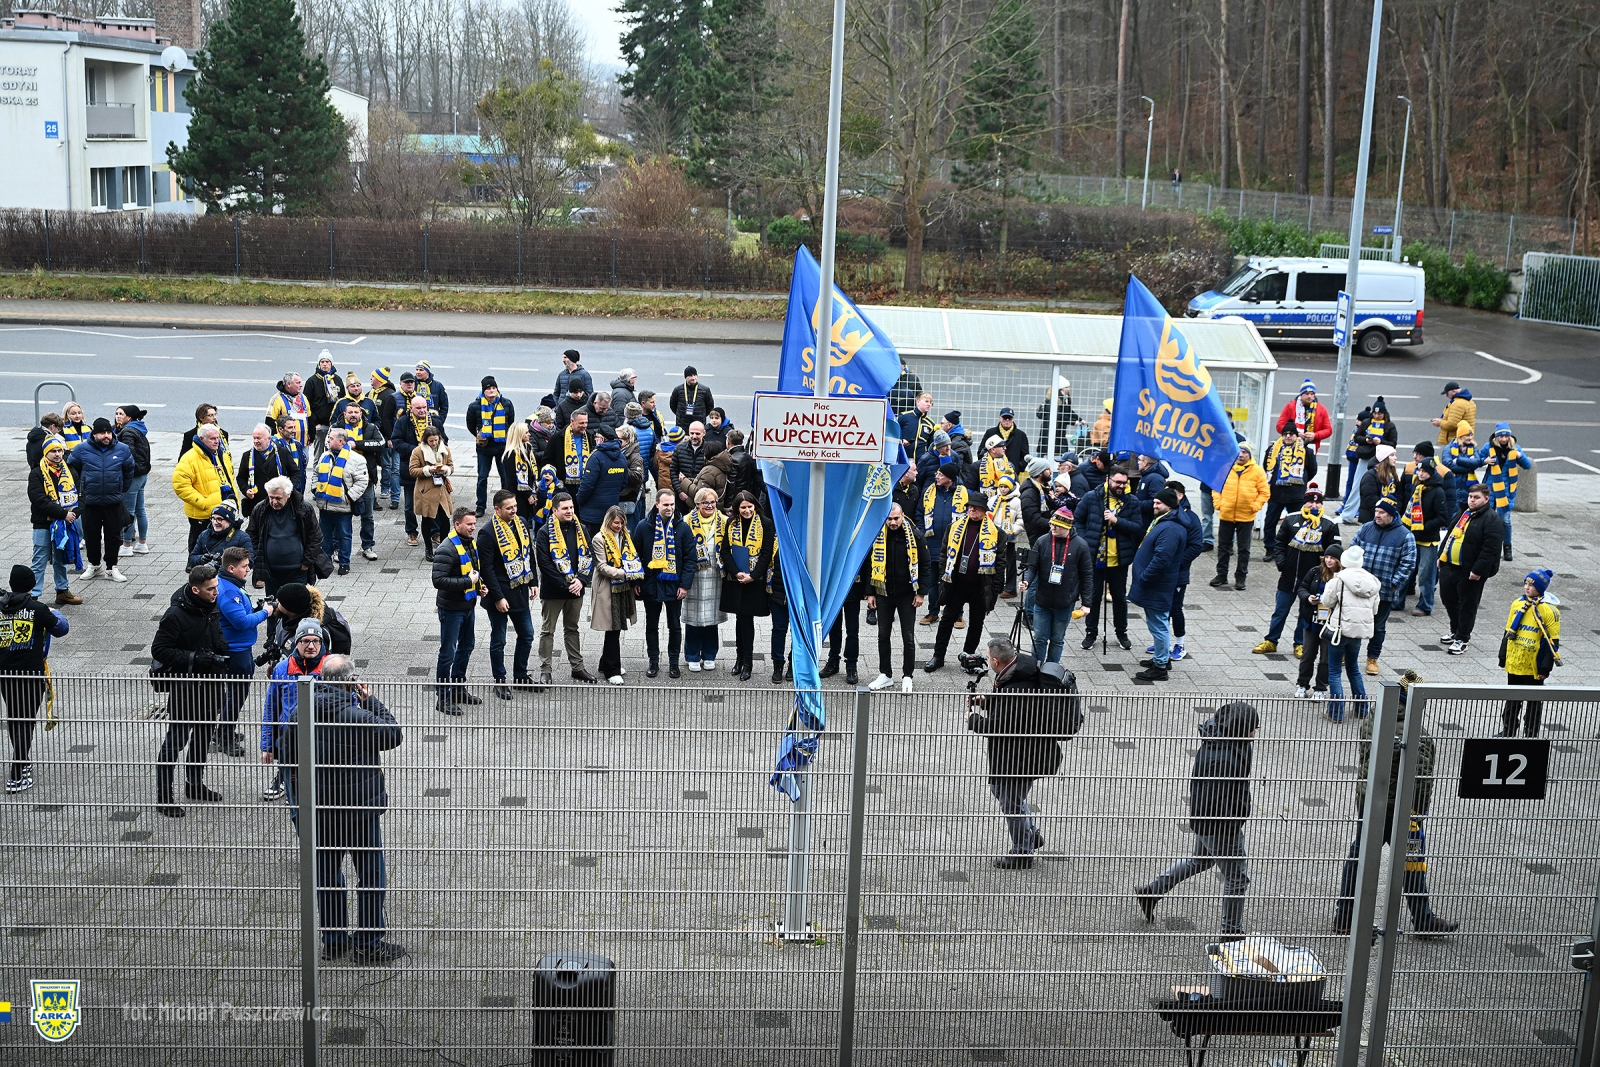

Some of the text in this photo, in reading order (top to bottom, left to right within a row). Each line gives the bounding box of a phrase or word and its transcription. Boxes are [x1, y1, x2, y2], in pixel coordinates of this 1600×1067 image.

[1, 81, 38, 91] GDYNI
[0, 96, 39, 106] SKA 25
[46, 124, 57, 133] 25
[813, 403, 830, 411] Plac
[782, 411, 859, 428] JANUSZA
[763, 427, 878, 446] KUPCEWICZA
[797, 450, 841, 458] Mały Kack
[1161, 436, 1205, 462] DYNIA
[1482, 753, 1528, 785] 12
